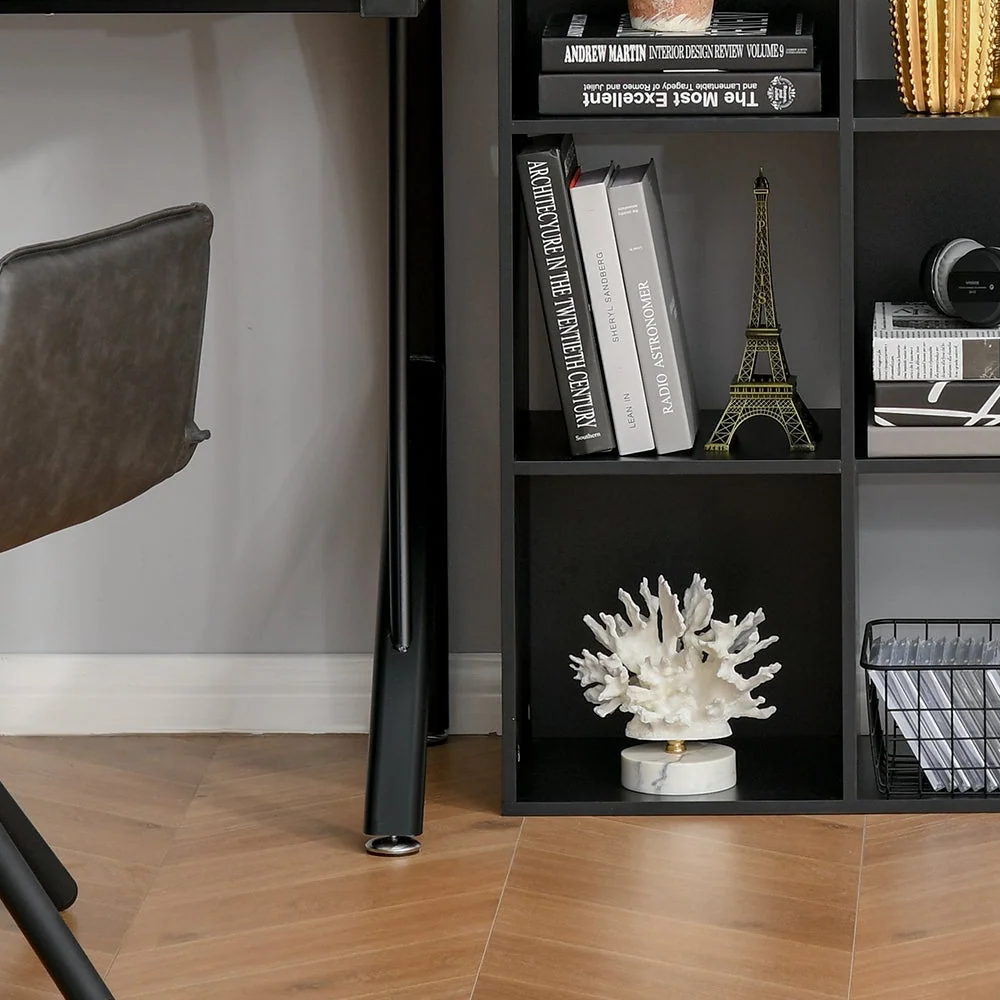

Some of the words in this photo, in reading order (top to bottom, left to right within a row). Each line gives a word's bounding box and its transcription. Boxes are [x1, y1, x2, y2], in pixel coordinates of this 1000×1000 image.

[564, 45, 606, 63] ANDREW
[608, 44, 646, 63] MARTIN
[649, 44, 685, 60] INTERIOR
[685, 44, 714, 59] DESIGN
[714, 44, 744, 58] REVIEW
[746, 43, 779, 58] VOLUME
[779, 44, 784, 58] 9
[623, 83, 651, 91] Romeo
[652, 83, 662, 91] of
[662, 82, 694, 91] Tragedy
[695, 82, 741, 90] Lamentable
[742, 82, 758, 90] and
[582, 91, 667, 108] Excellent
[673, 91, 717, 107] Most
[724, 91, 759, 107] The
[547, 254, 562, 271] IN
[551, 271, 571, 297] THE
[596, 251, 613, 302] SANDBERG
[605, 302, 619, 343] SHERYL
[637, 280, 665, 368] ASTRONOMER
[555, 297, 583, 371] TWENTIETH
[569, 371, 597, 429] CENTURY
[624, 392, 632, 405] IN
[655, 374, 673, 413] RADIO
[628, 407, 636, 429] LEAN
[575, 432, 601, 442] Southern
